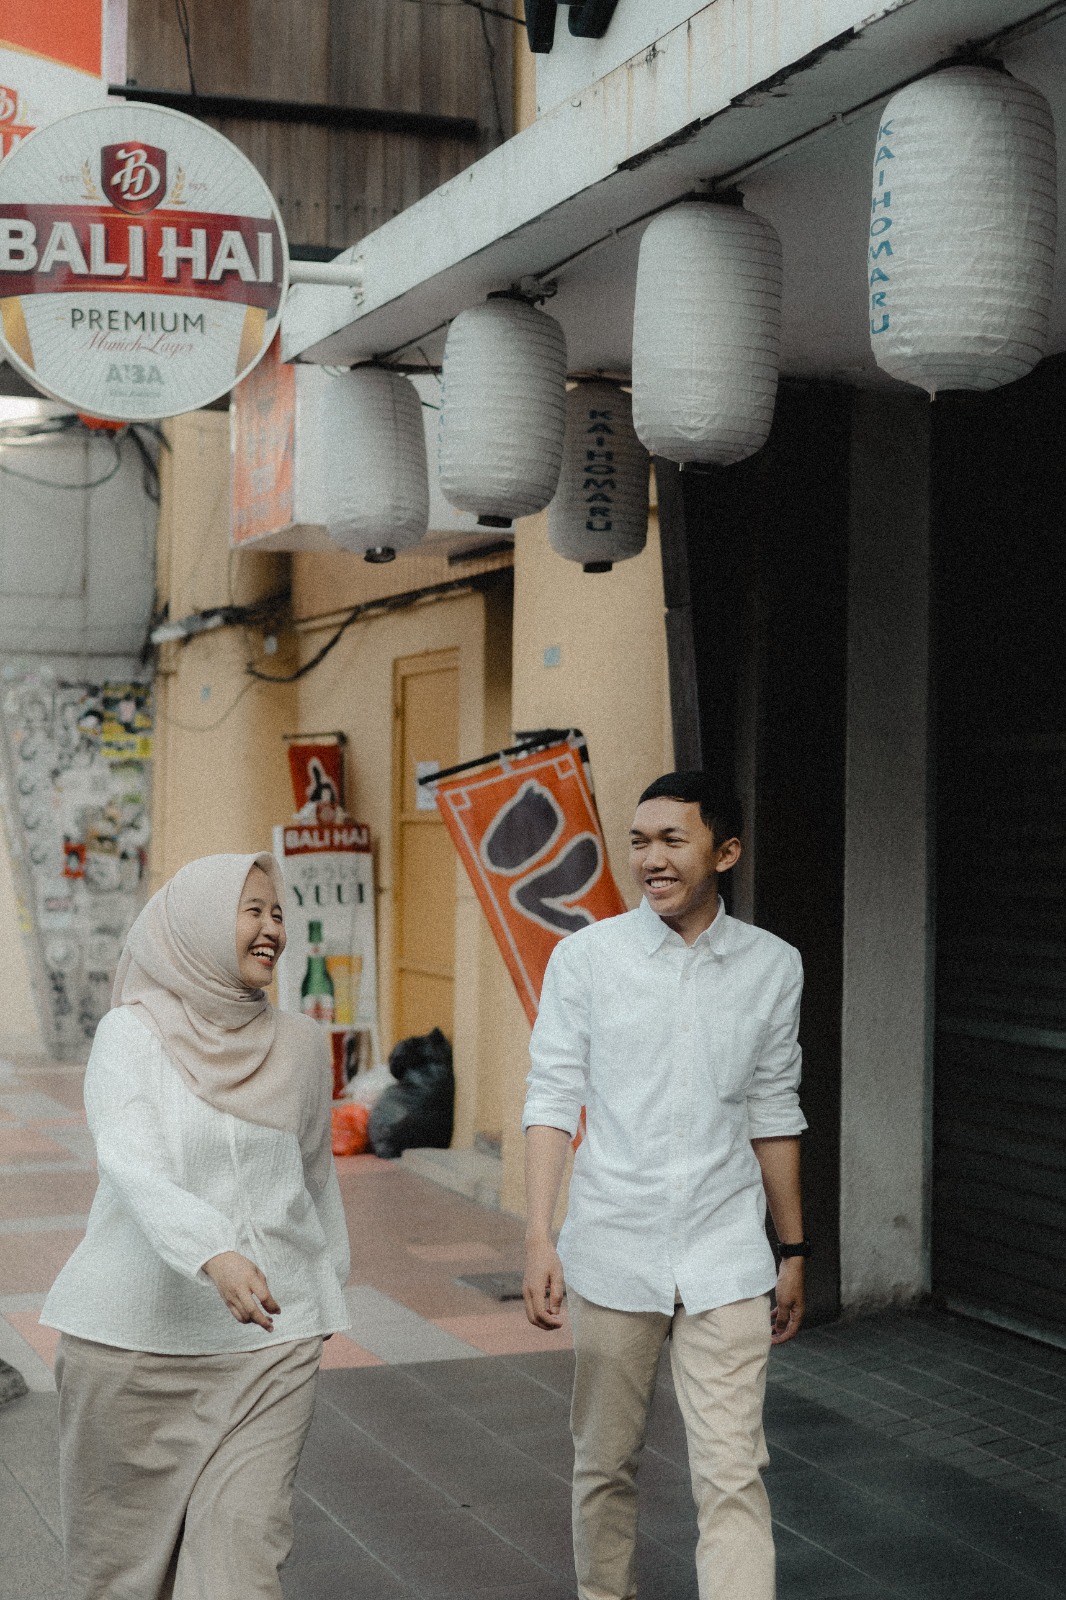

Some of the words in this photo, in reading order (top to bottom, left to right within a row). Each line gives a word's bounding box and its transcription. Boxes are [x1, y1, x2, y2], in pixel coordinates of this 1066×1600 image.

[868, 119, 896, 335] KAIHOMARU
[0, 217, 145, 278] BALI
[158, 226, 274, 284] HAI
[70, 308, 206, 334] PREMIUM
[143, 332, 195, 358] Lager
[583, 409, 617, 532] KAIHOMARU
[286, 828, 331, 850] BALI
[333, 827, 368, 847] HAI
